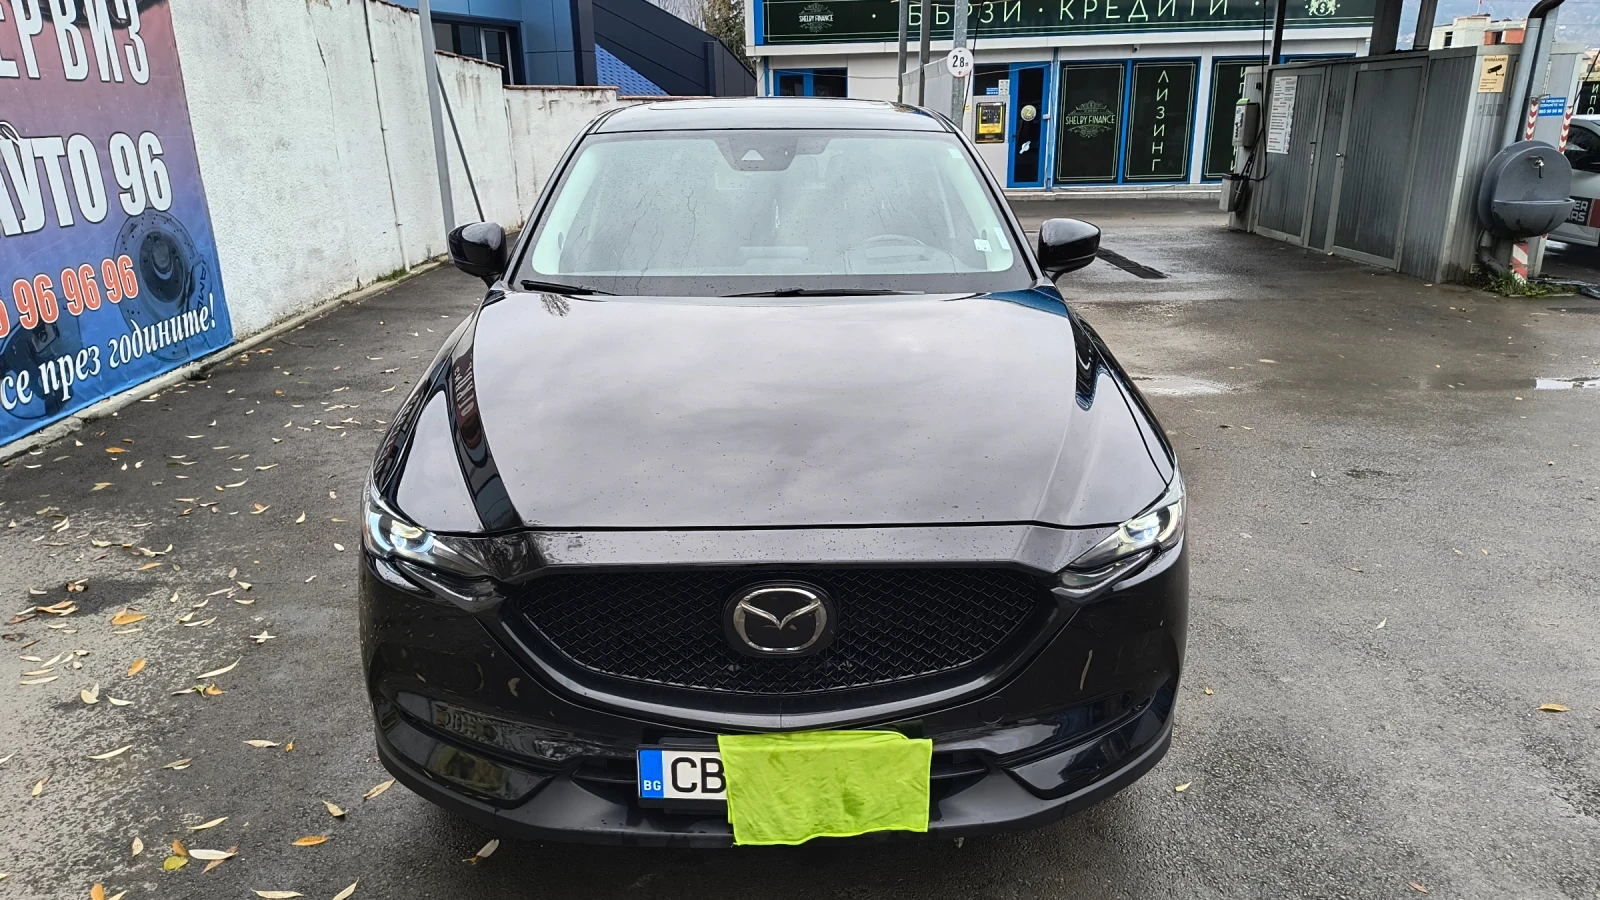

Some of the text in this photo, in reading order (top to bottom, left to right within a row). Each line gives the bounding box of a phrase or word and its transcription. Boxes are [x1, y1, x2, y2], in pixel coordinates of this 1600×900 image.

[1088, 114, 1116, 125] FINANCE
[1151, 69, 1170, 172] ЛИЗИНГ
[109, 131, 173, 217] 96
[1569, 211, 1586, 222] RS
[13, 274, 59, 331] 96
[60, 263, 101, 316] 96
[101, 254, 139, 304] 96
[38, 344, 101, 402] през
[108, 292, 216, 369] годините!
[643, 780, 661, 791] BG
